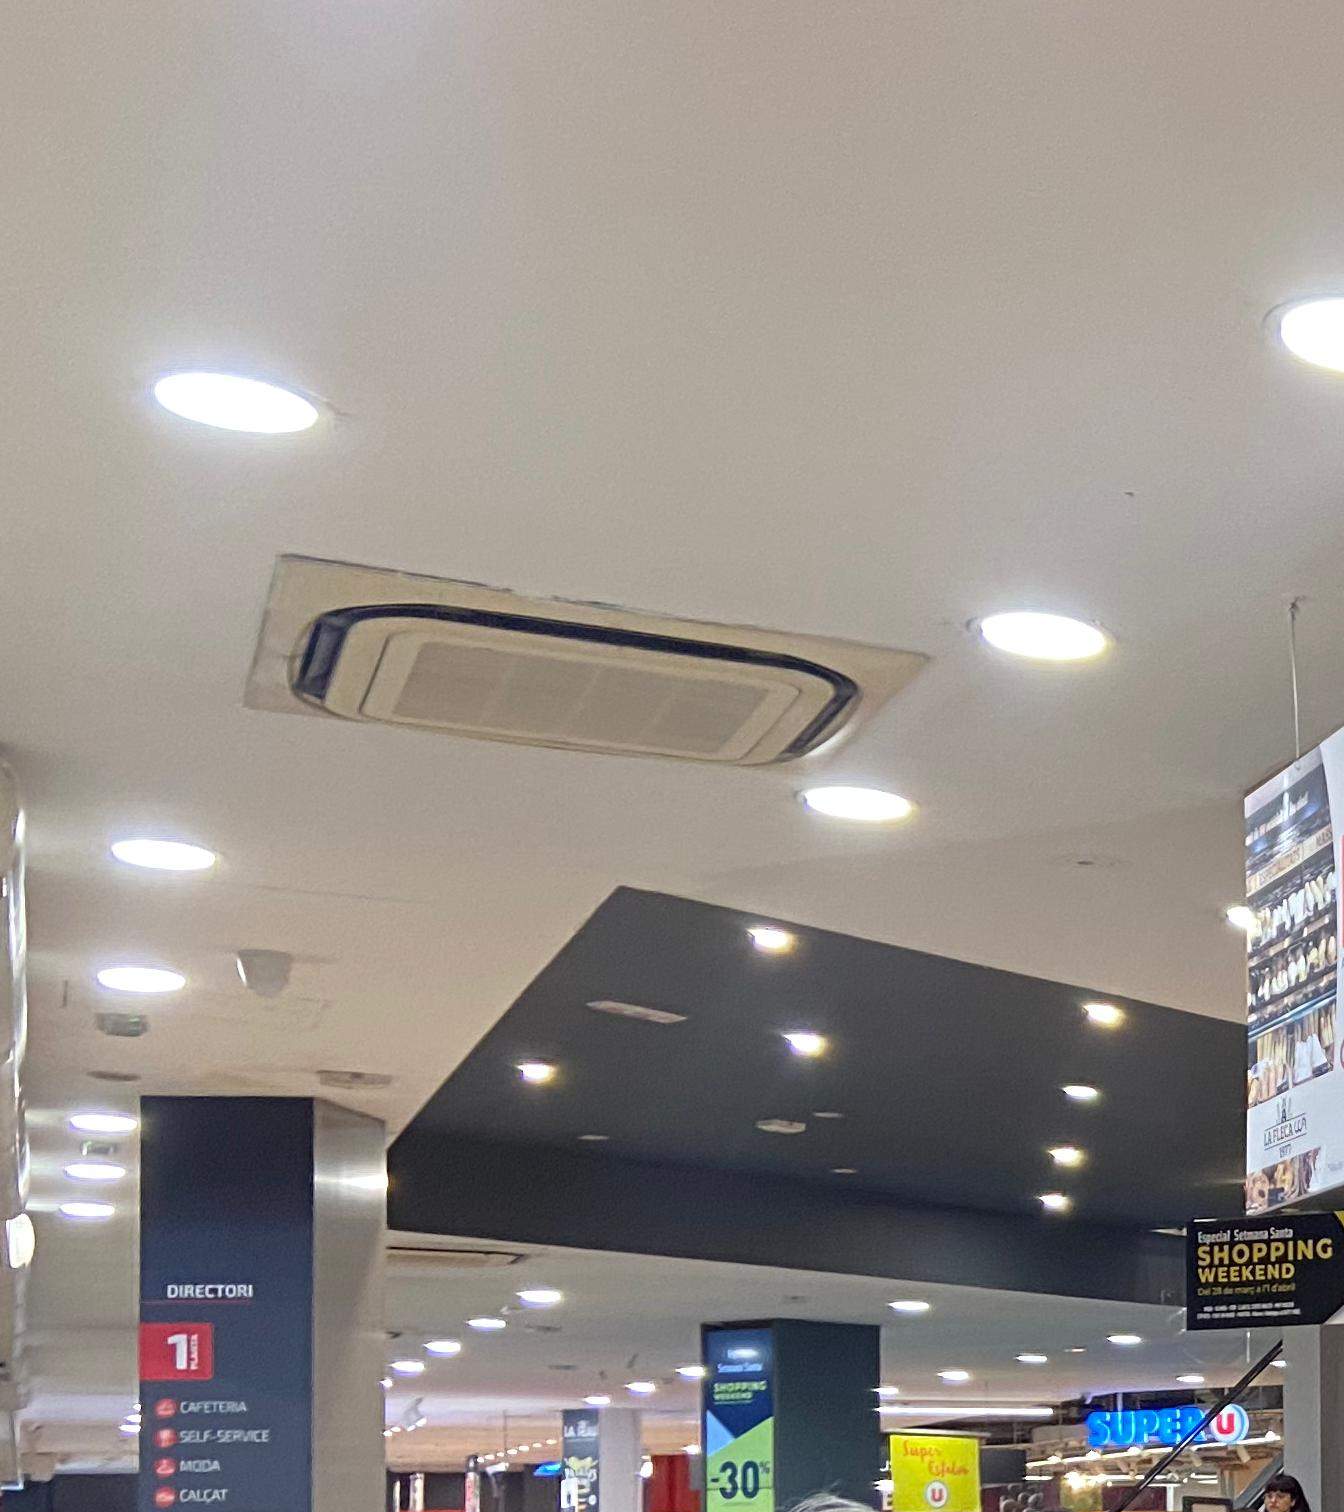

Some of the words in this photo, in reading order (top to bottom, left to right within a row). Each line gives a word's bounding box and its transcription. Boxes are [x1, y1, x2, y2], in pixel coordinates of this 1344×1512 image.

[1198, 1230, 1231, 1244] Especial
[1233, 1229, 1269, 1241] Setmana
[1270, 1227, 1294, 1239] Santa
[1197, 1237, 1334, 1266] SHOPPING
[1197, 1263, 1296, 1284] WEEKEND
[166, 1284, 254, 1299] DIRECTORI
[167, 1333, 189, 1371] 1
[180, 1401, 247, 1414] CAFETERIA
[1087, 1405, 1207, 1447] SUPER
[179, 1429, 271, 1443] SELF-SERVICE
[179, 1460, 221, 1472] MODA
[179, 1489, 228, 1504] CALÇAT
